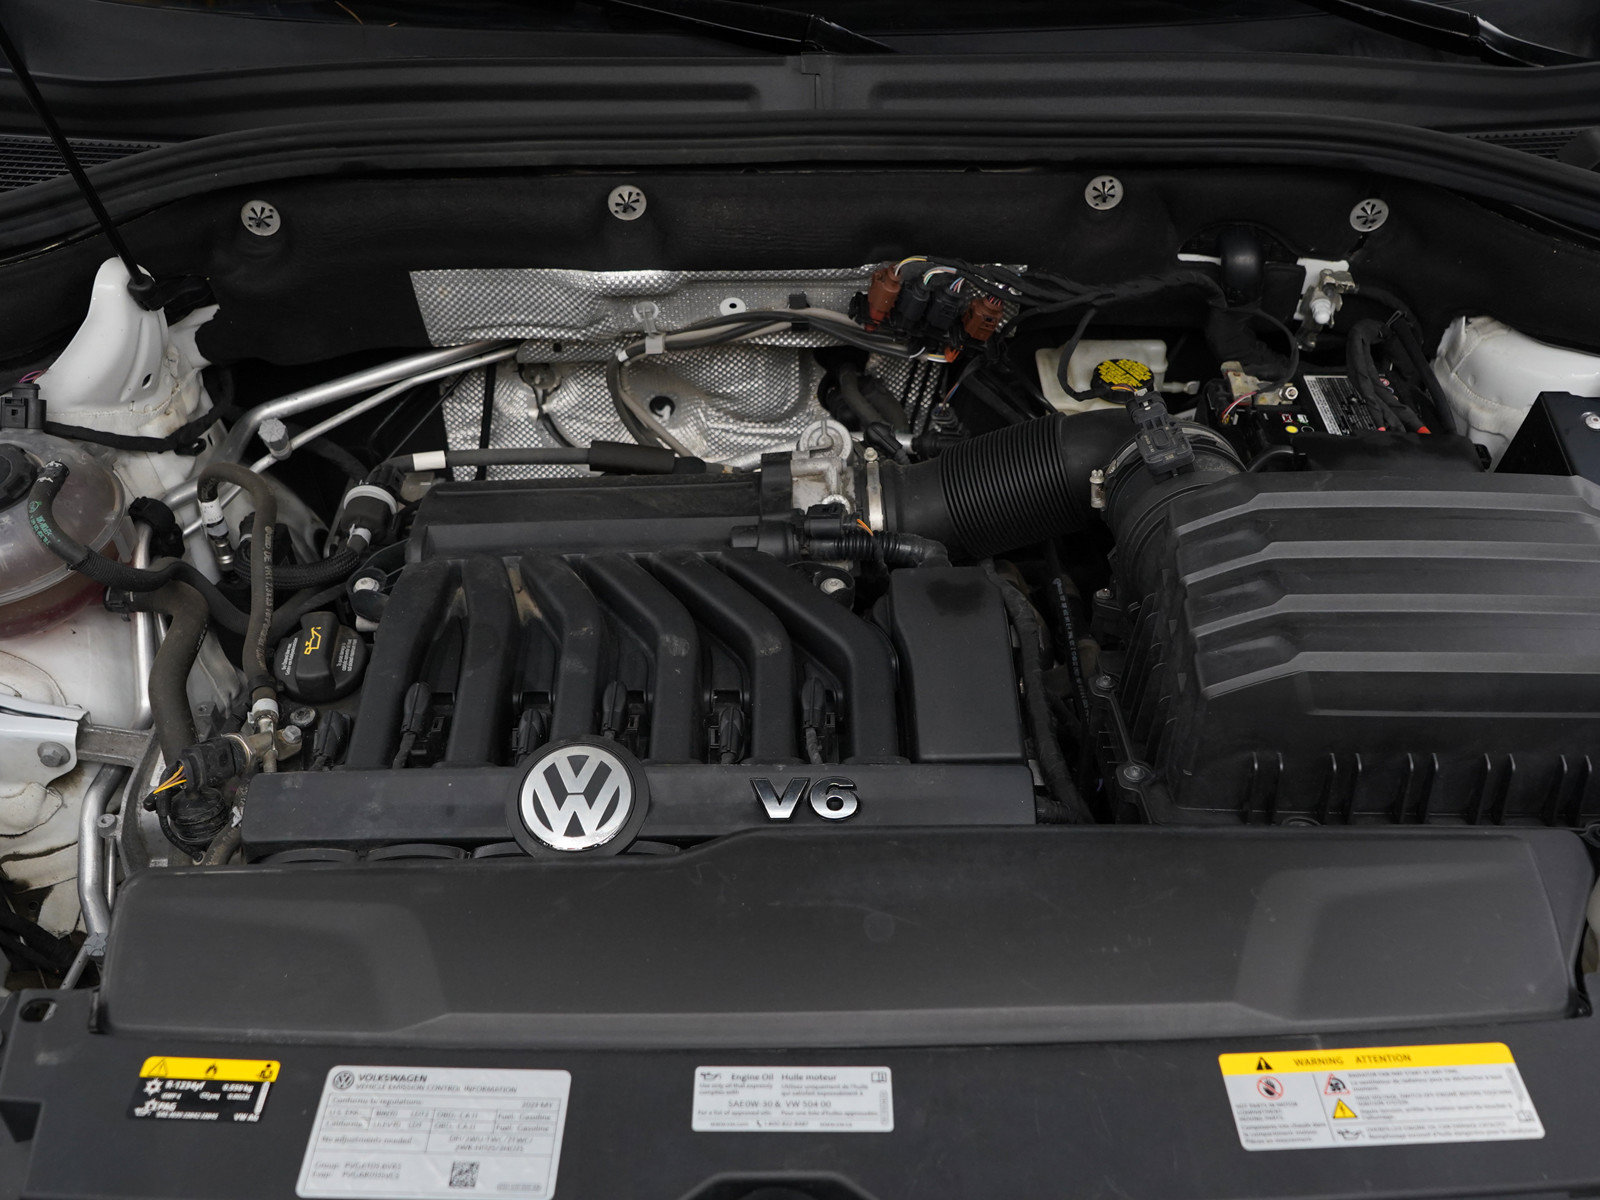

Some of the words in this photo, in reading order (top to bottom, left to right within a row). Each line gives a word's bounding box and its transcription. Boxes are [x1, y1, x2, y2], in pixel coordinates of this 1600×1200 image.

[750, 776, 859, 820] V6
[1293, 1056, 1344, 1066] WARNING
[1354, 1053, 1411, 1063] ATTENTION
[359, 1073, 427, 1082] VOLKSWAGEN
[731, 1073, 759, 1081] Engine
